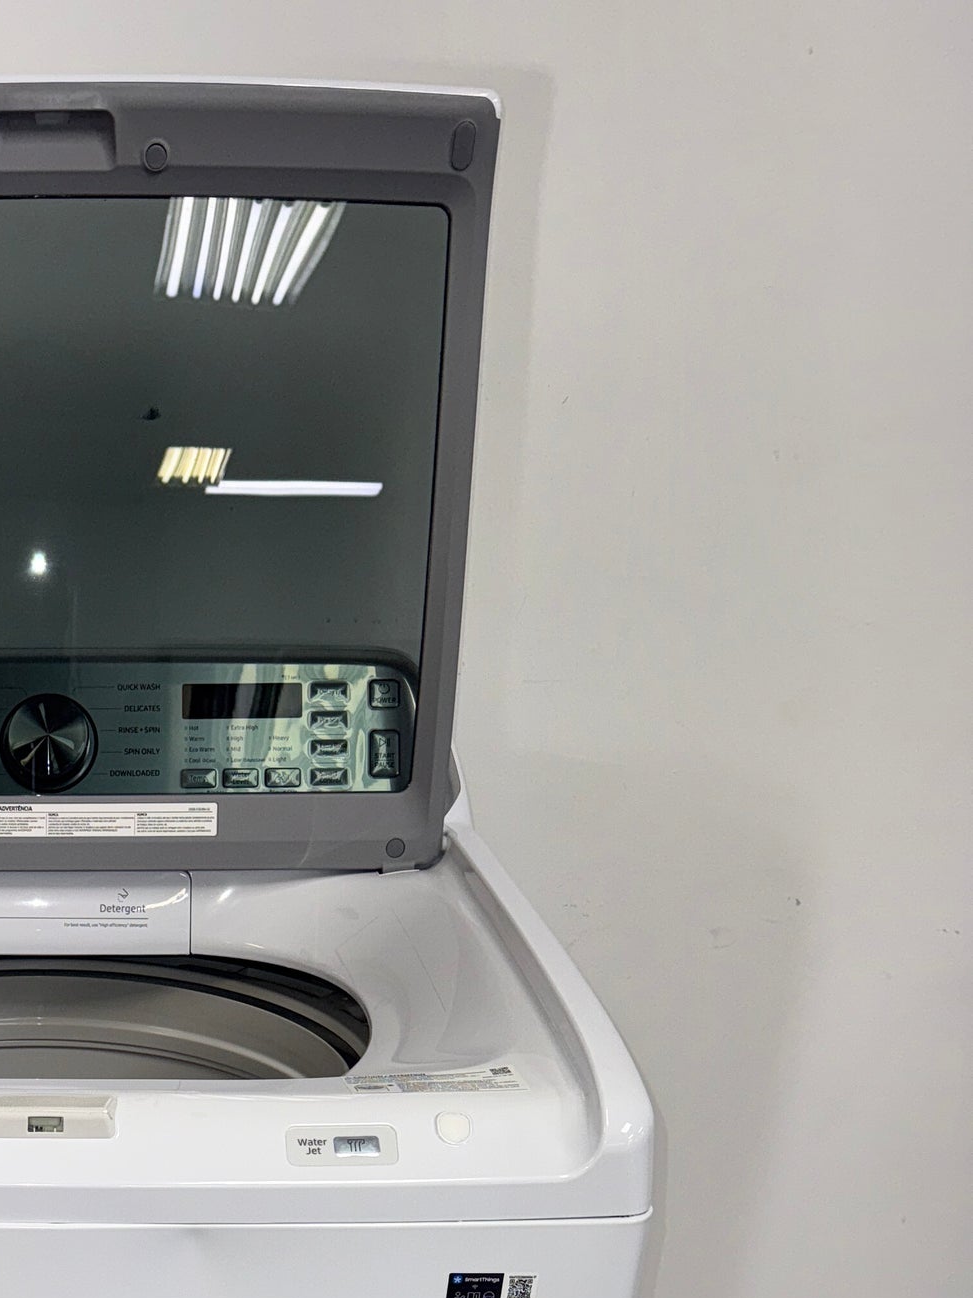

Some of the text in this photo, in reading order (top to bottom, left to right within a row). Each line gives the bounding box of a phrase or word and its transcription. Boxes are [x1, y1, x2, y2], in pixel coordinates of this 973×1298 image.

[117, 683, 139, 692] QUICK
[118, 726, 137, 734] RINSE
[145, 726, 161, 734] SPIN
[124, 748, 160, 756] SPIN ONLY
[374, 752, 395, 760] START
[99, 903, 146, 914] Detergent
[297, 1138, 327, 1146] Water
[306, 1147, 322, 1156] Jet
